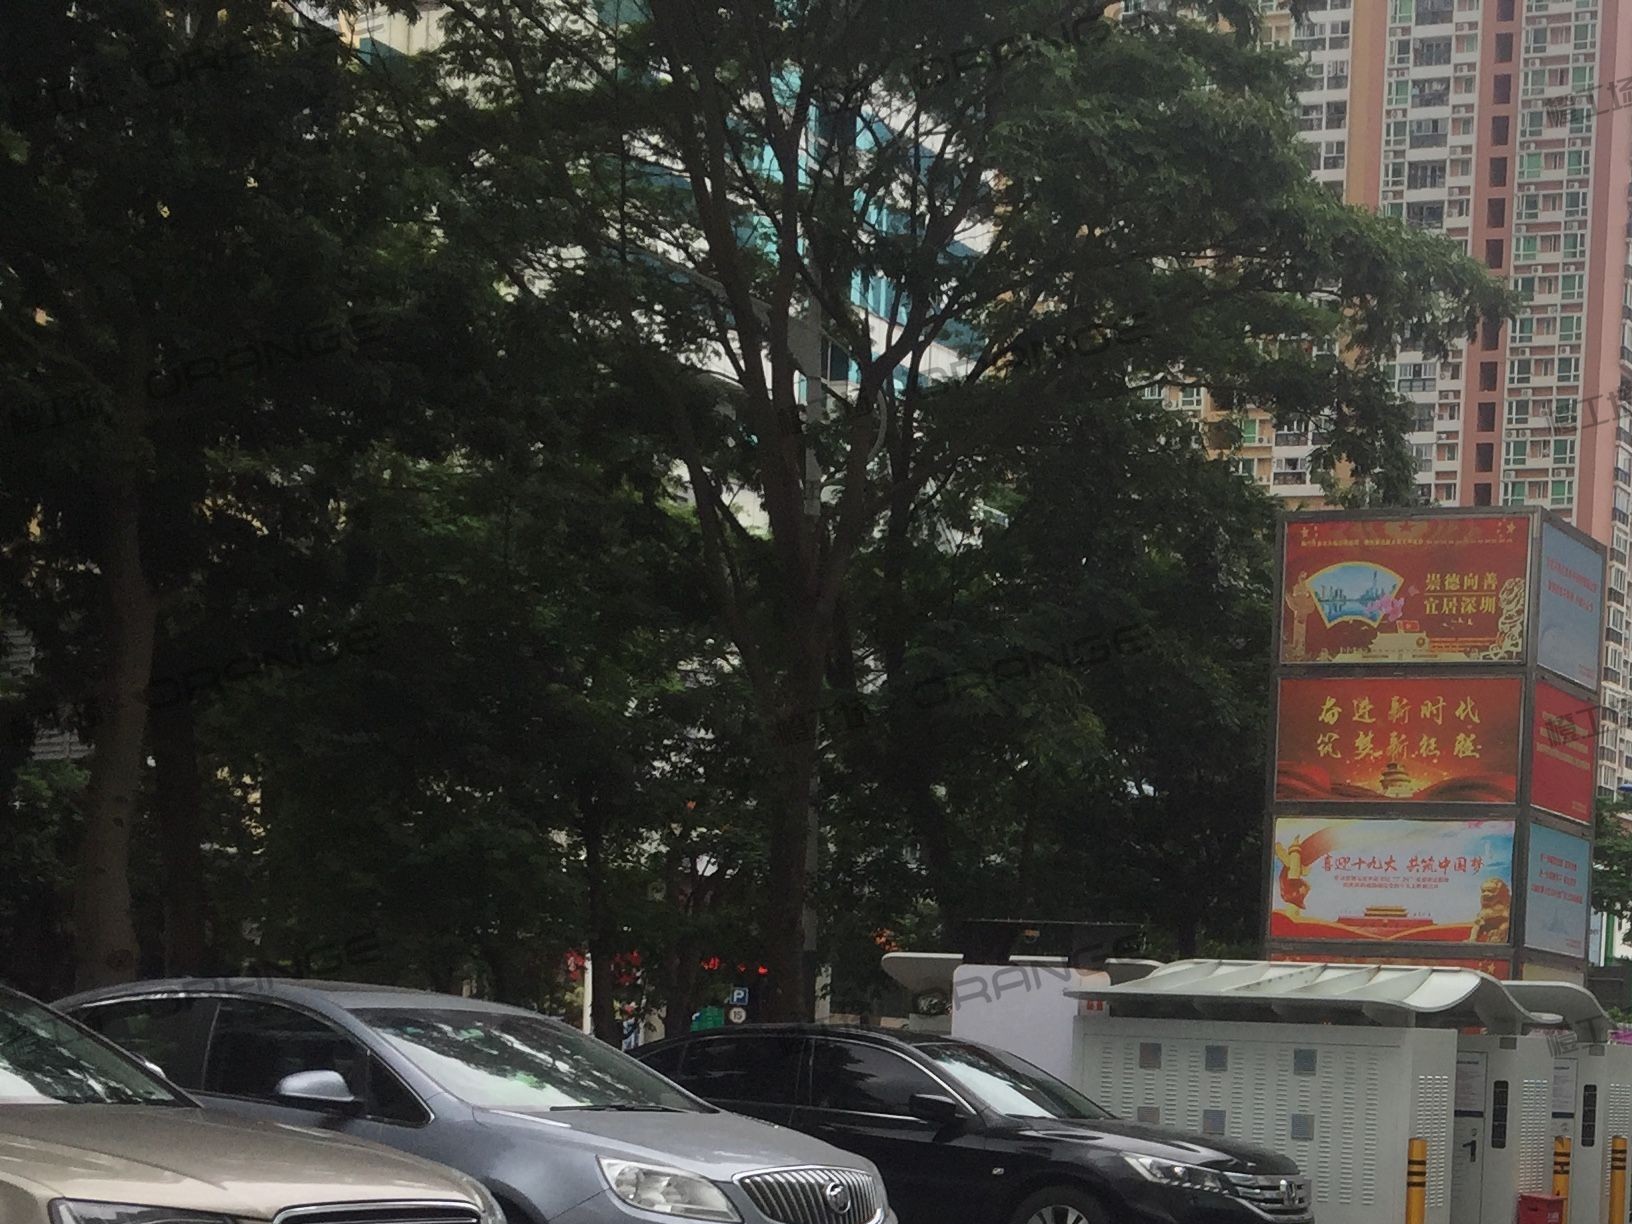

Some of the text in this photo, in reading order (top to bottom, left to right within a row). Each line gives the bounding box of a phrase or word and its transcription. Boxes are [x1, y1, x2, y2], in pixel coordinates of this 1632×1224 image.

[1425, 571, 1498, 591] 崇德向善
[1423, 596, 1497, 615] 宜居深圳
[1318, 695, 1480, 725] 奋进新时代
[1316, 730, 1480, 760] 筑梦新征程
[1322, 853, 1485, 875] 喜迎十九大 共筑中国梦
[733, 989, 744, 1001] P
